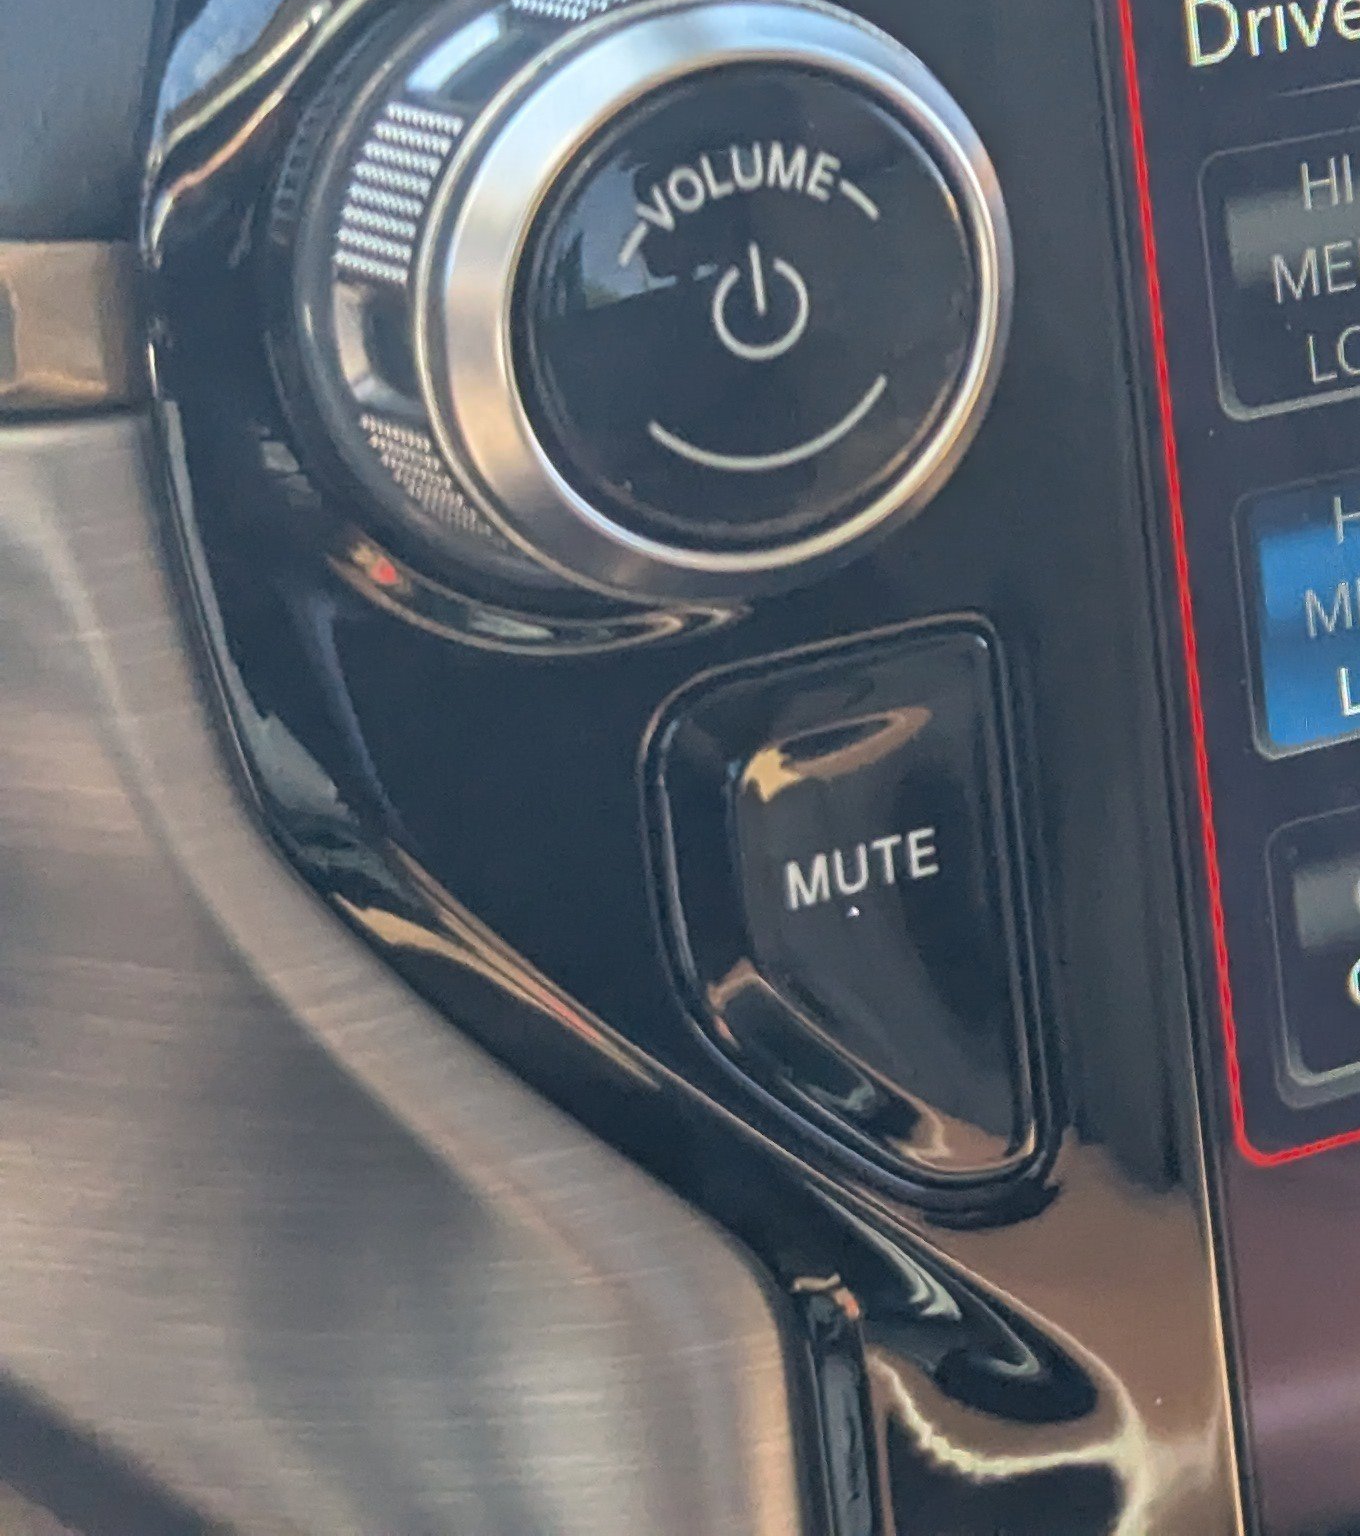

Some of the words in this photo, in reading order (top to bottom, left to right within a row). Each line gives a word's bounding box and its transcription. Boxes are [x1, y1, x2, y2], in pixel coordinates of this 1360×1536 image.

[636, 140, 842, 232] VOLUME
[1301, 153, 1355, 211] HI
[786, 825, 940, 911] MUTE
